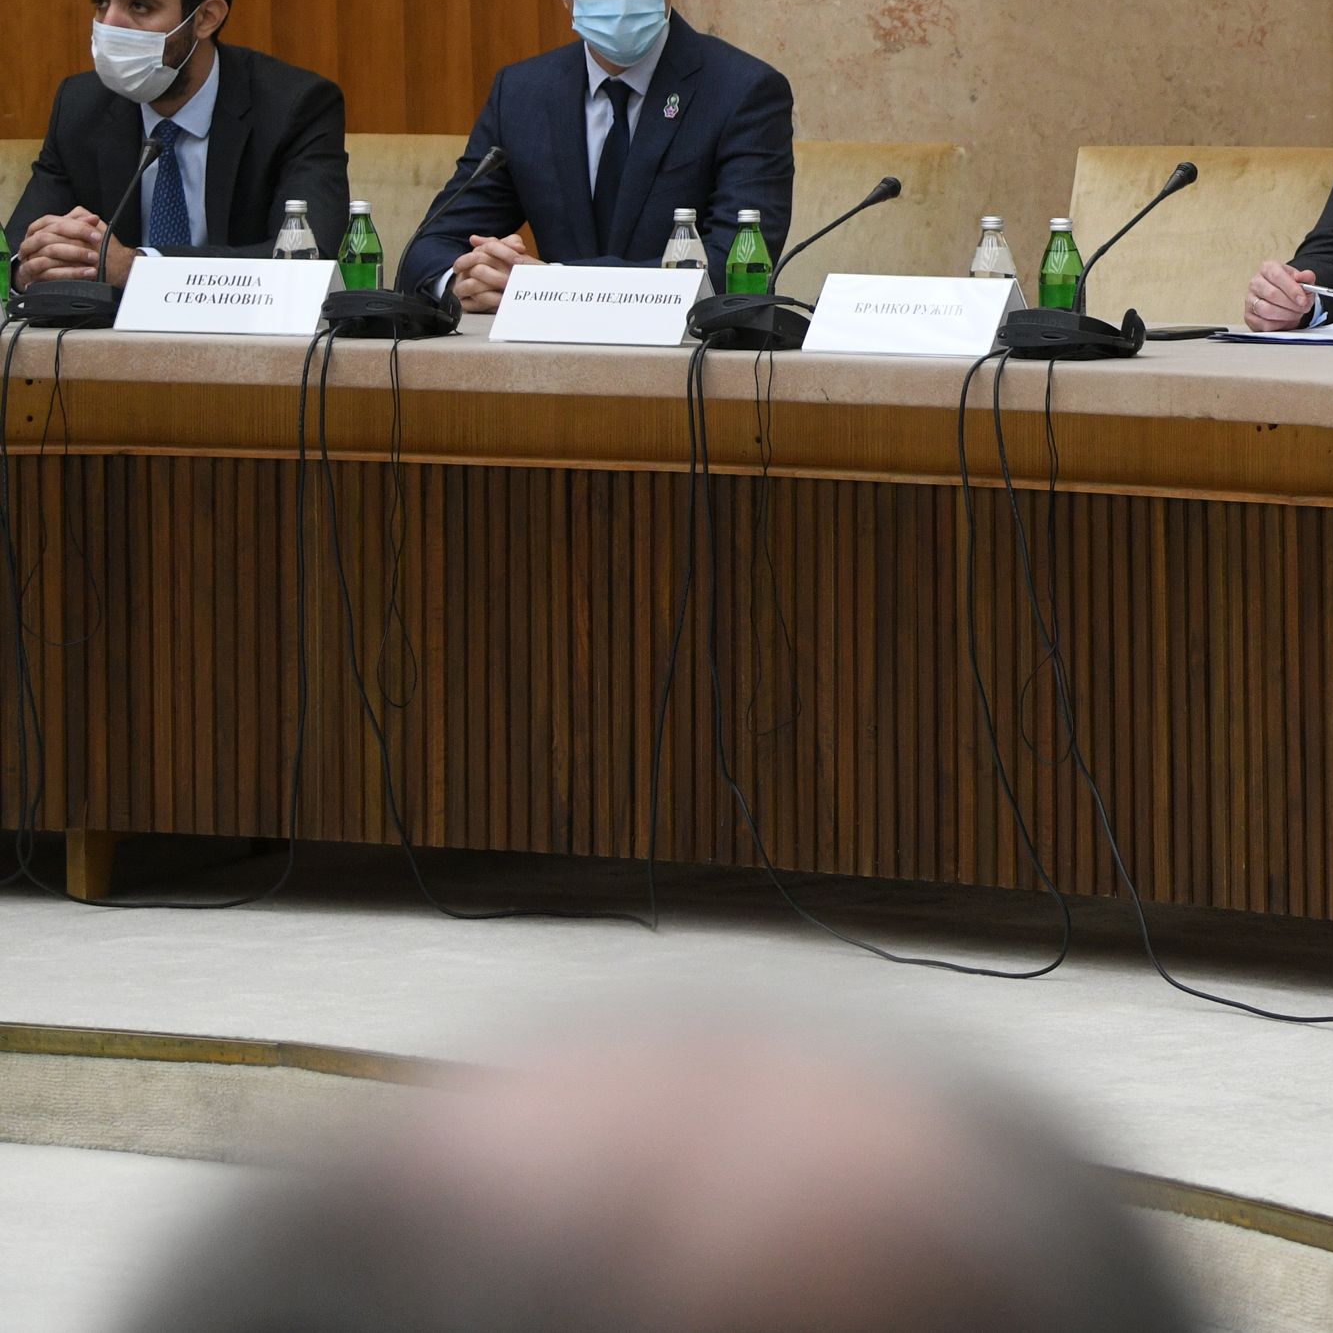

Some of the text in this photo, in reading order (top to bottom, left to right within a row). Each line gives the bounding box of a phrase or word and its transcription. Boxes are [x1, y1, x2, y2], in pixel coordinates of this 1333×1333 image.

[186, 273, 262, 288] НЕБОЈША
[164, 291, 274, 306] СТЕФАНОВИЋ
[514, 290, 682, 305] БРАНИСЛАВ НЕДИМОВИЋ
[854, 302, 964, 316] БРАНКО РУЖИЋ
